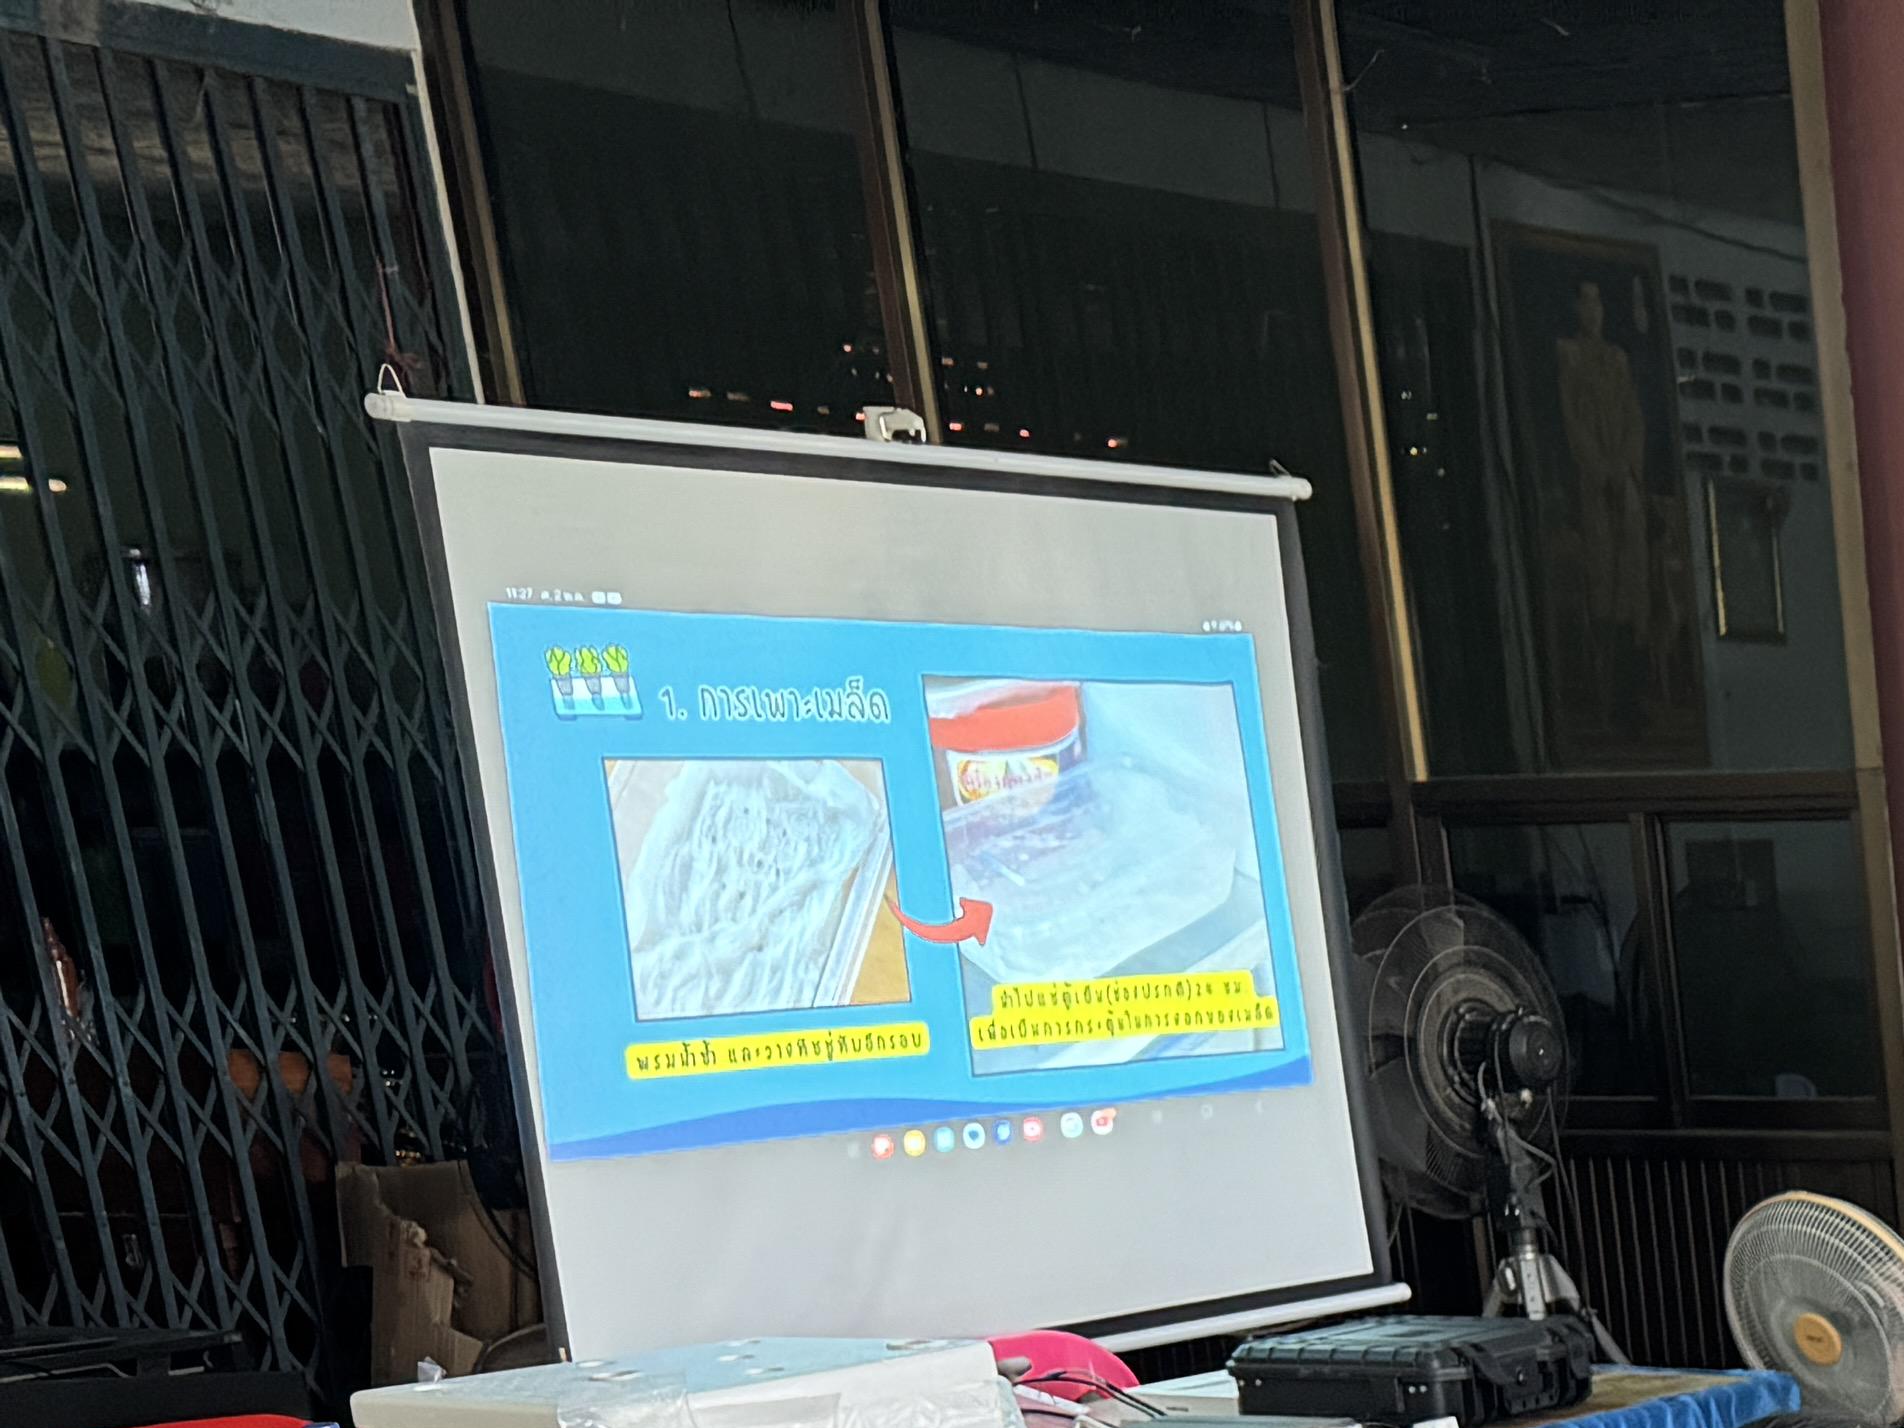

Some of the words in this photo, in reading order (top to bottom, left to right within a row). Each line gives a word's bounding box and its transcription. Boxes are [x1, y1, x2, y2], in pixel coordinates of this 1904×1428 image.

[659, 686, 688, 721] 1.
[699, 675, 892, 723] การเพาะเมล็ด
